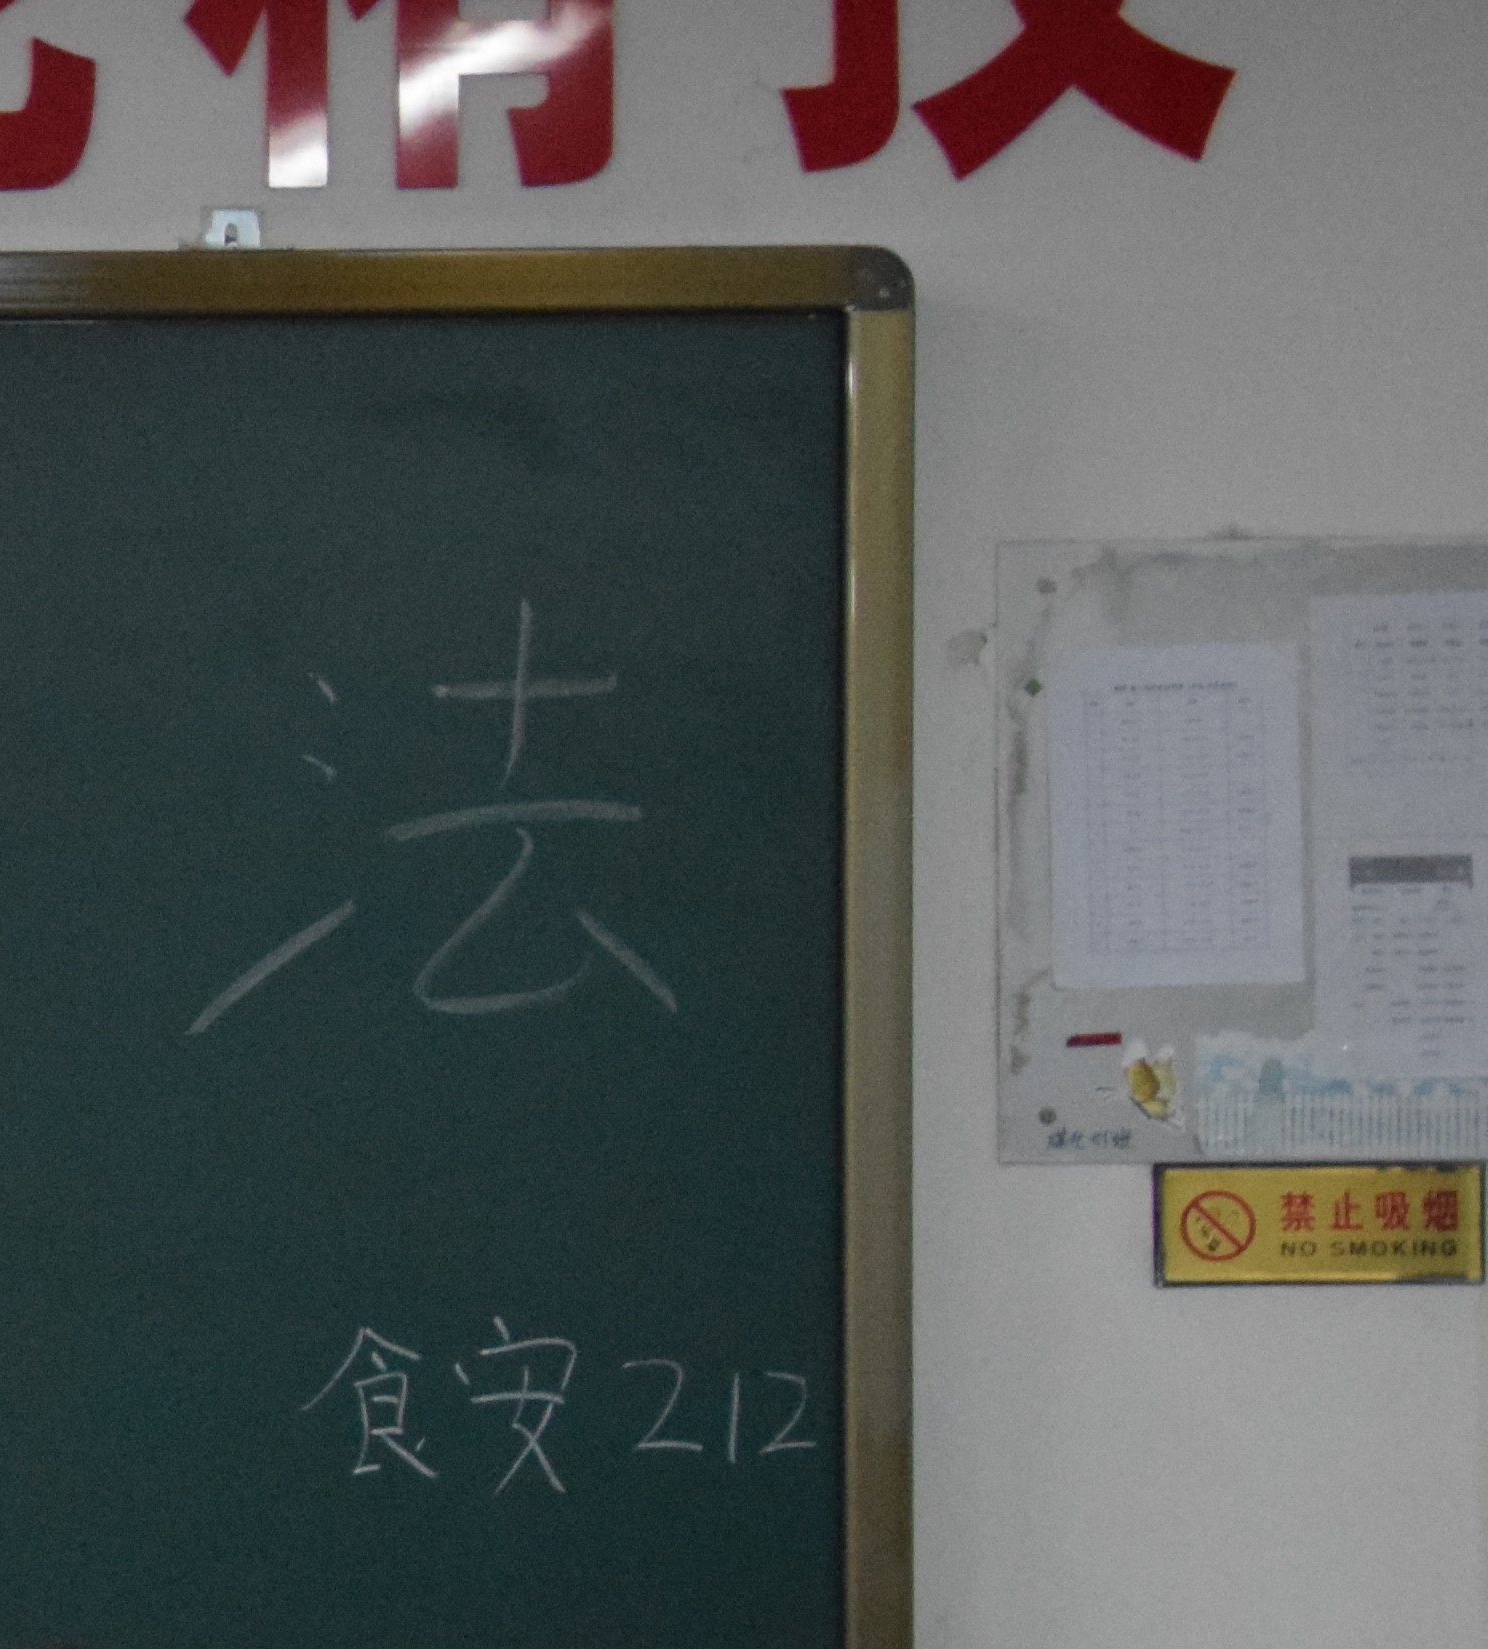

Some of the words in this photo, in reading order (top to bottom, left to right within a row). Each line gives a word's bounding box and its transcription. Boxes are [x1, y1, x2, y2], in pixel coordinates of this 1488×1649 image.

[1280, 1189, 1459, 1233] 禁止吸烟
[1281, 1239, 1318, 1258] NO
[1330, 1238, 1458, 1258] SMOKING
